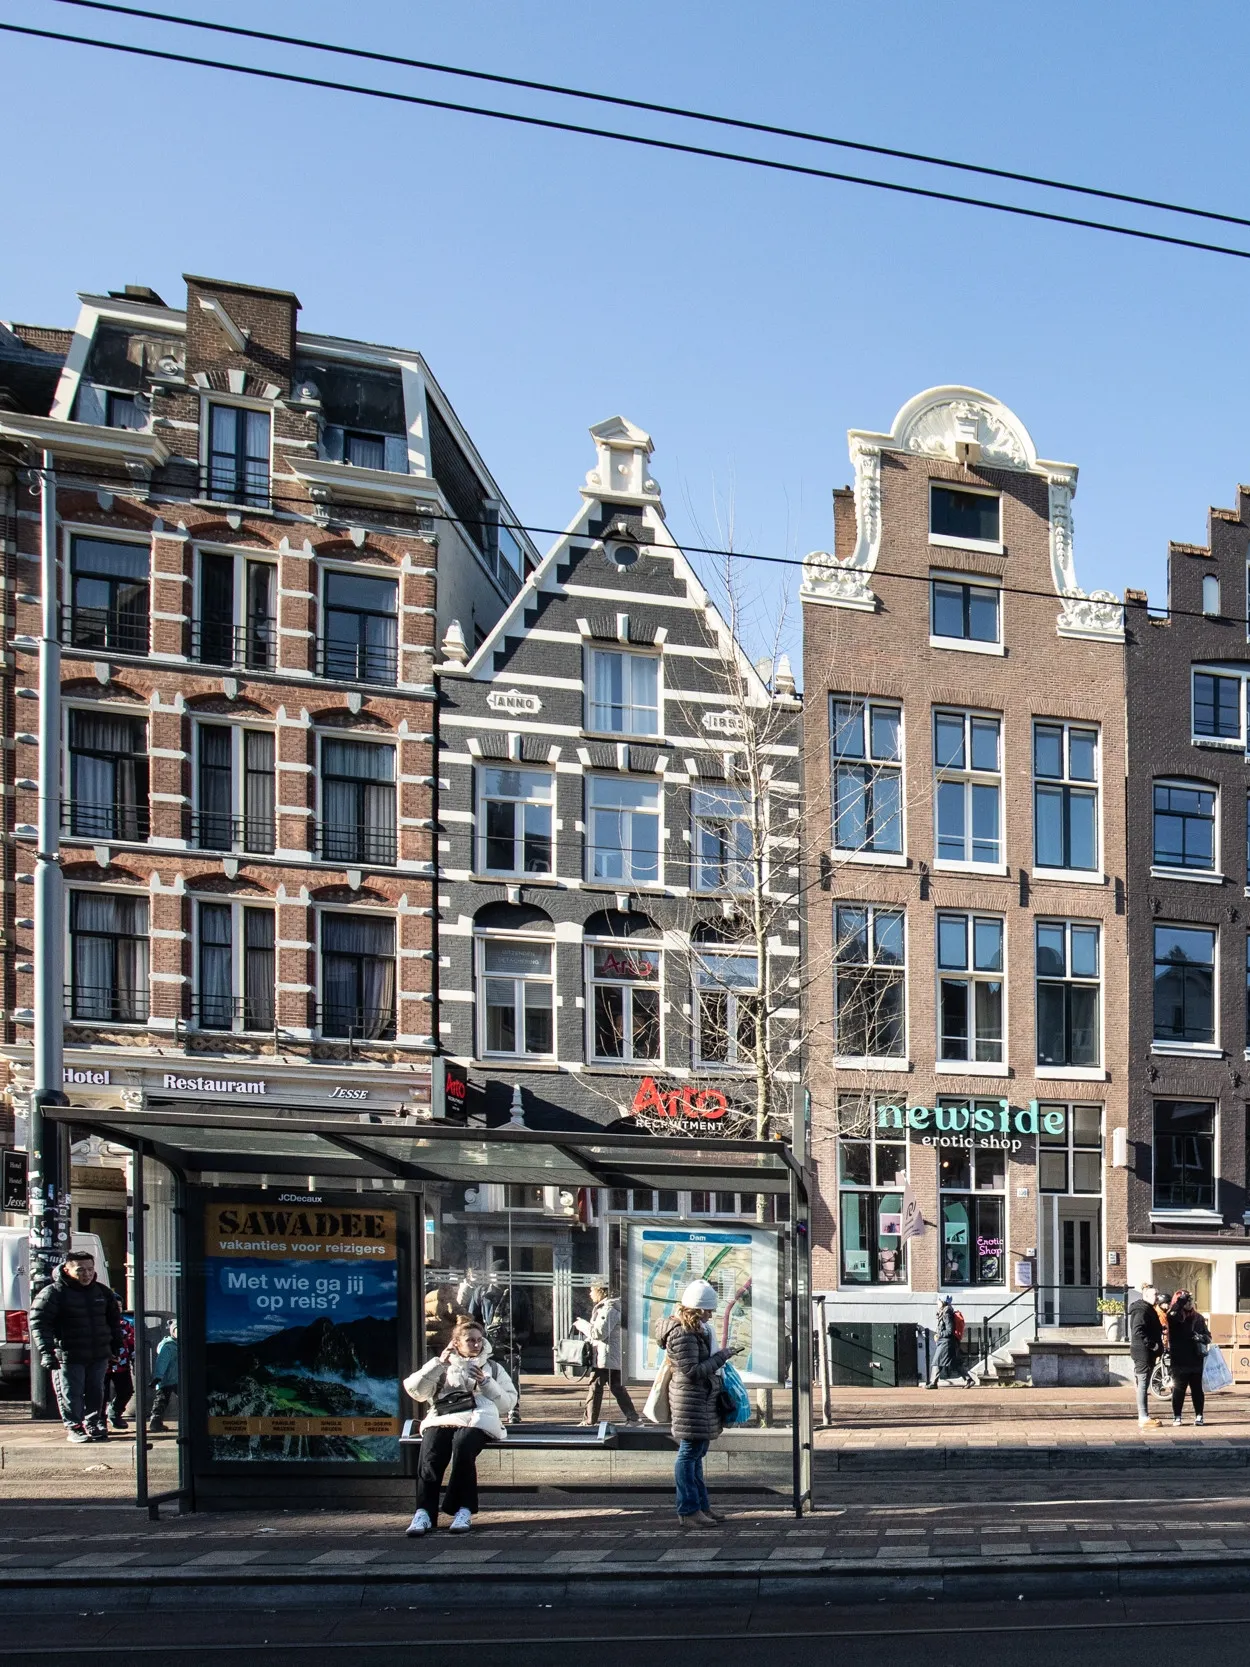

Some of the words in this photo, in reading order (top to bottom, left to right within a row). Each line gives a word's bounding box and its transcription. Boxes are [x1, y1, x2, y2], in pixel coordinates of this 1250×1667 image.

[497, 695, 535, 709] ANNO
[63, 1067, 110, 1085] Hotel
[163, 1073, 267, 1095] Restaurant
[630, 1076, 729, 1119] Arto
[876, 1098, 1065, 1135] newside
[921, 1133, 974, 1148] erotic
[980, 1134, 1022, 1153] shop
[5, 1196, 27, 1208] Jesse
[278, 1193, 323, 1203] JCDecaux
[218, 1210, 387, 1239] SAWADEE
[219, 1240, 287, 1252] vakanties
[291, 1243, 322, 1252] voor
[325, 1243, 386, 1255] reizigers
[976, 1236, 1004, 1246] Erotic
[978, 1245, 1003, 1258] Shop
[228, 1272, 269, 1290] Met
[273, 1274, 310, 1291] wie
[315, 1278, 342, 1294] ga
[346, 1275, 364, 1295] jij
[256, 1295, 284, 1311] op
[290, 1293, 341, 1309] reis?
